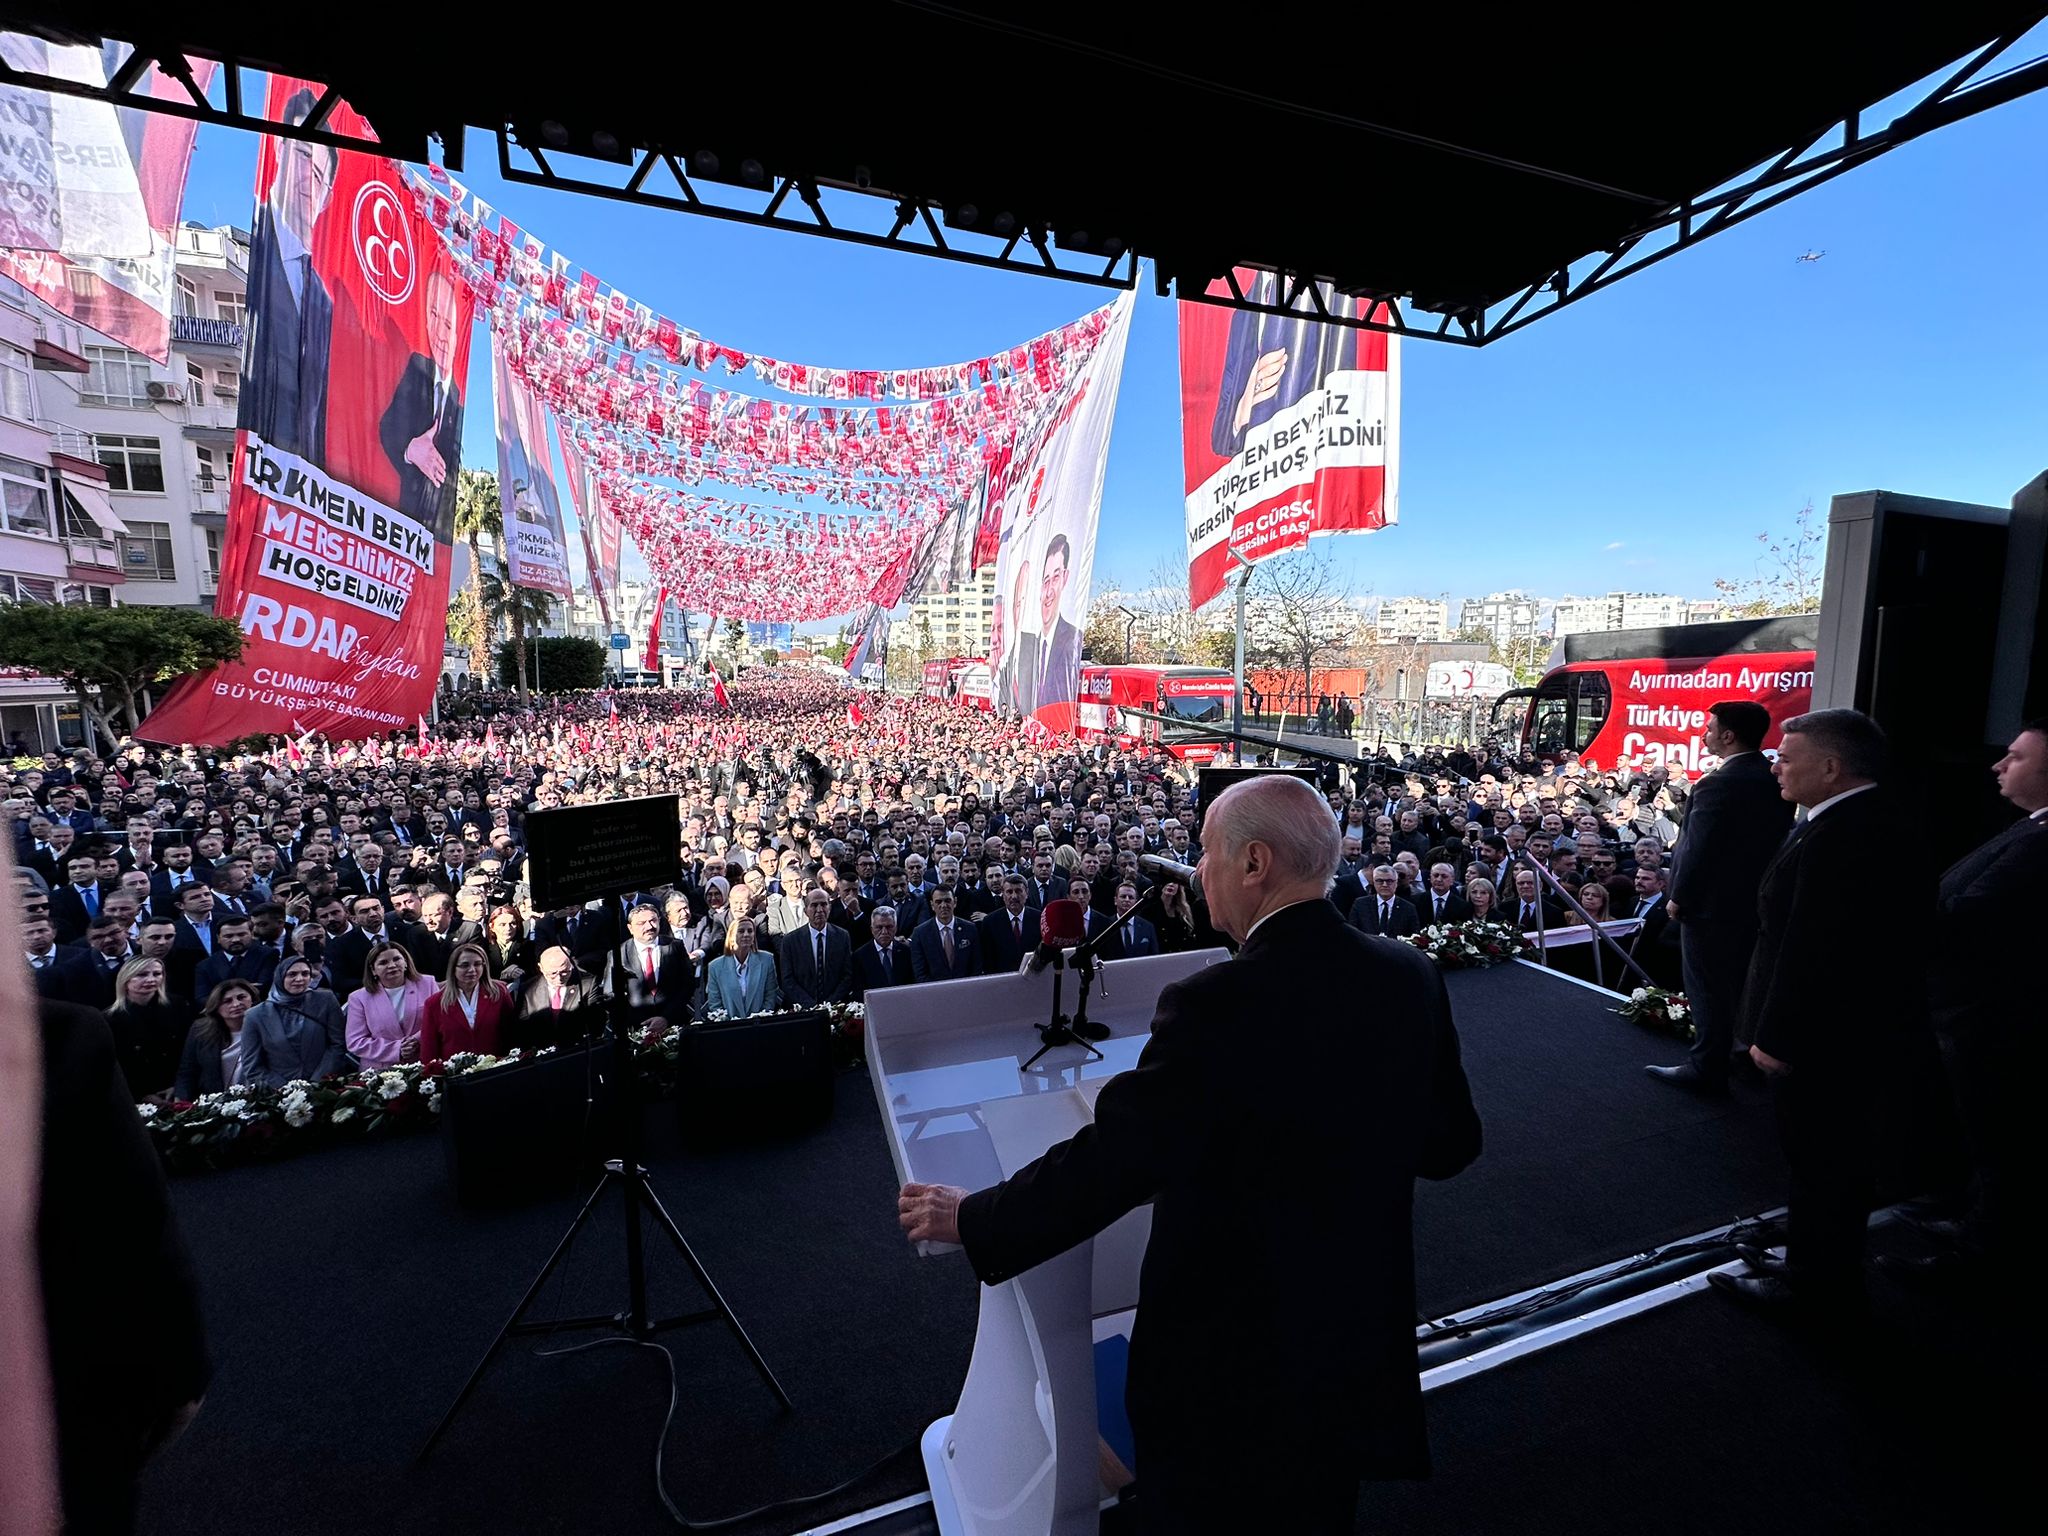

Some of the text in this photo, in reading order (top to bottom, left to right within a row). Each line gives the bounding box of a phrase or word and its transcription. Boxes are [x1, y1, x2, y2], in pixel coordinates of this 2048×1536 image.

[268, 547, 404, 615] HOŞGELDİNİZ
[1629, 667, 1815, 693] Ayırmadan Ayrışm
[1626, 704, 1705, 732] Türkiye
[568, 857, 586, 868] bu
